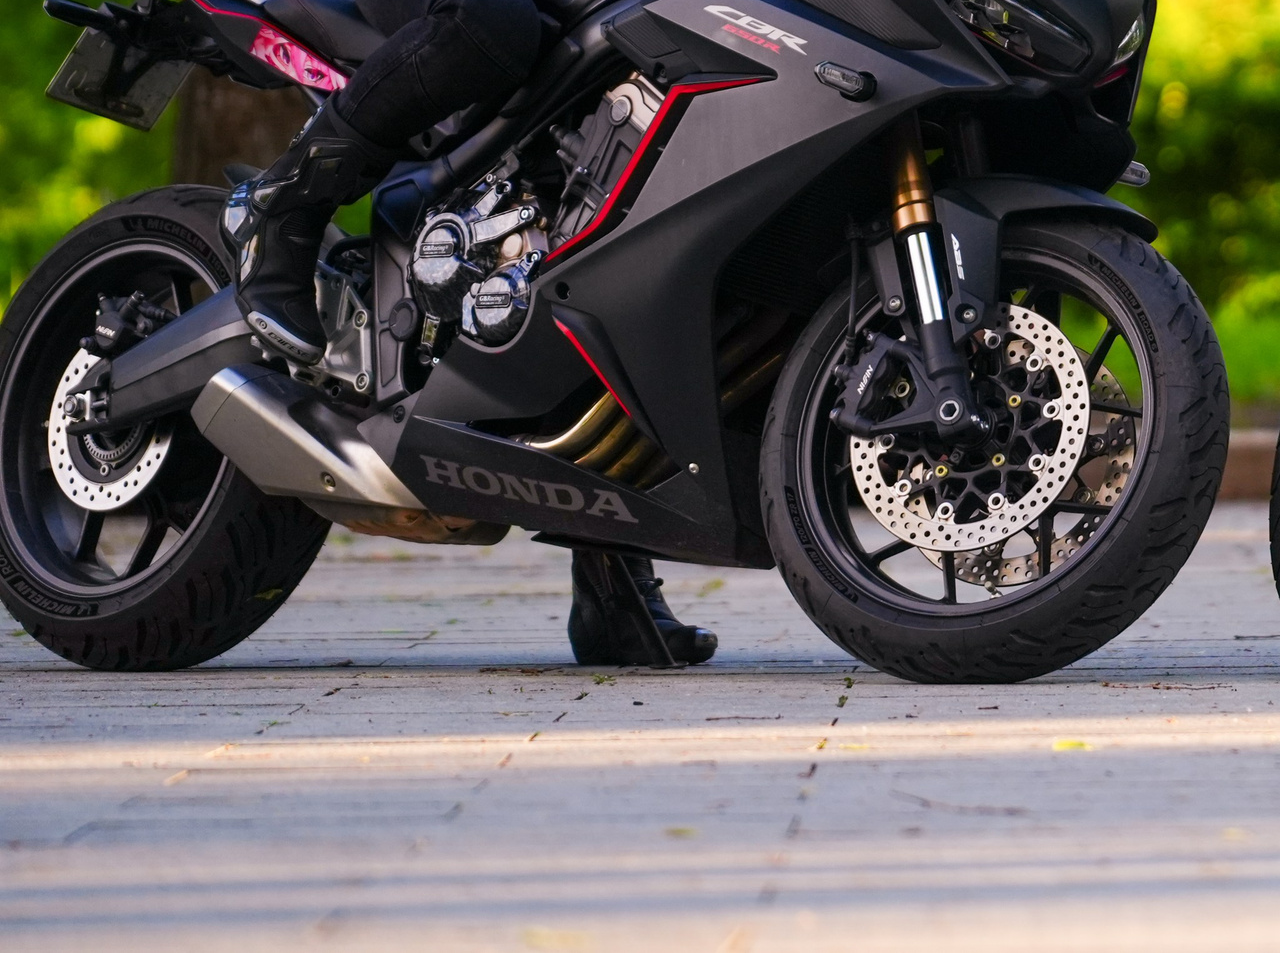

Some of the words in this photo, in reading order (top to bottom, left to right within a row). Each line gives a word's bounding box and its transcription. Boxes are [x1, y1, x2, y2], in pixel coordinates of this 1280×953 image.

[703, 4, 808, 56] CBR
[721, 23, 781, 55] 650R
[147, 218, 207, 252] MICHELIN
[951, 232, 965, 281] ABS
[1102, 265, 1138, 307] MICHELIN
[1139, 313, 1155, 342] ROAD
[419, 454, 639, 524] HONDA
[809, 551, 846, 592] MICHELIN
[16, 579, 75, 615] MICHELIN
